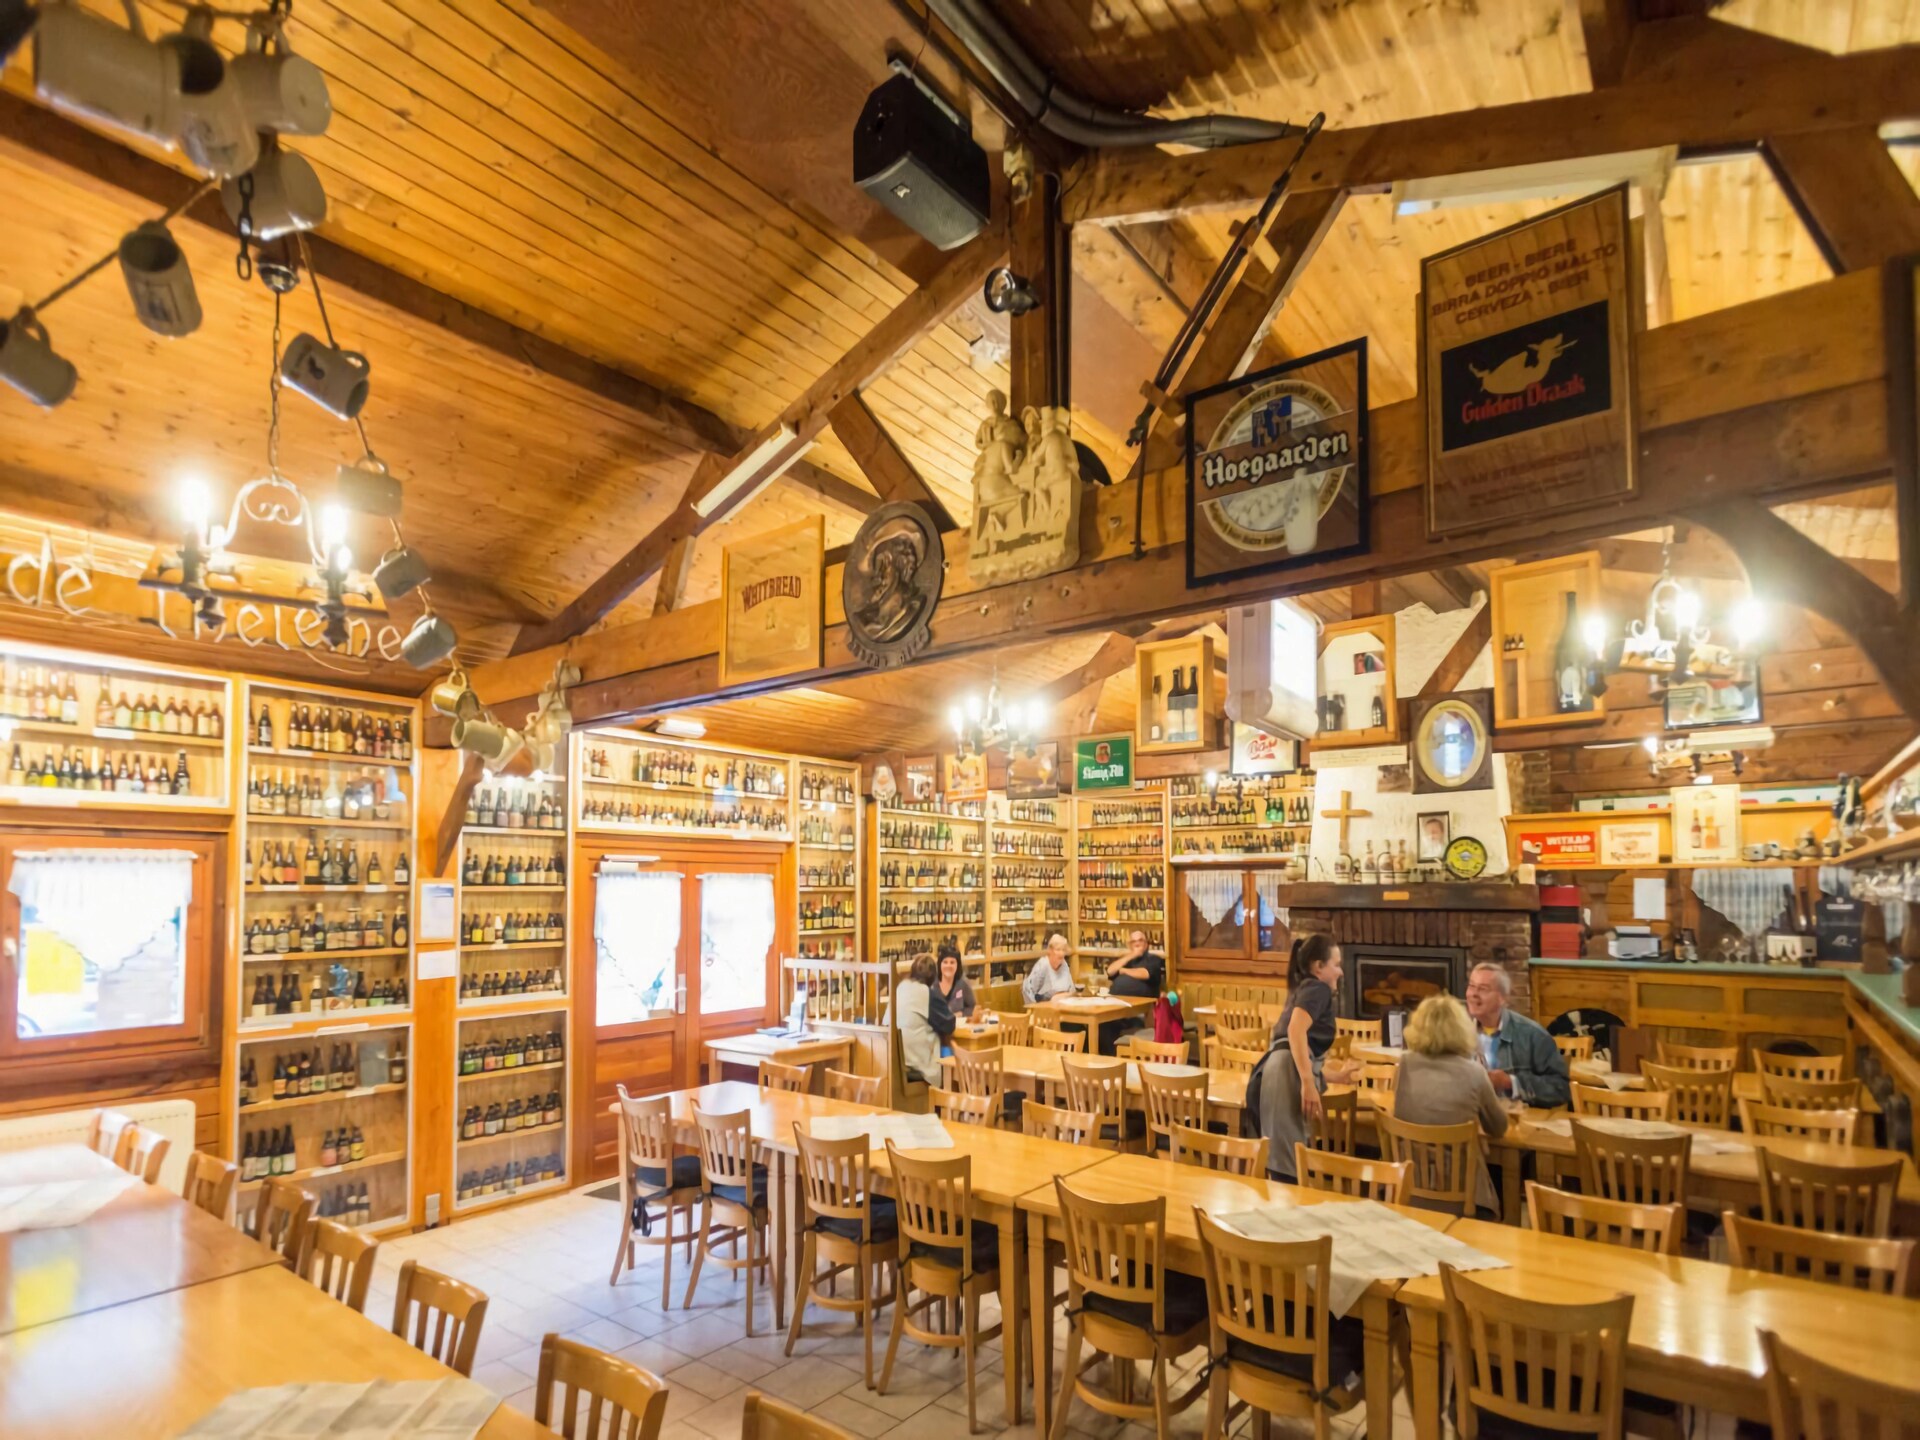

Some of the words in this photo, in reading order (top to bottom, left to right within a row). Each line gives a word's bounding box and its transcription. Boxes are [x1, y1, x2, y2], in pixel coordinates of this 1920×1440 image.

[1432, 290, 1481, 316] BIRRA
[1485, 266, 1549, 298] DOPPIO
[1555, 243, 1617, 273] MALTO
[1466, 264, 1510, 287] BEER
[1455, 292, 1532, 324] CERVEZA
[1463, 396, 1523, 423] Gulden
[1526, 375, 1585, 406] Draak
[1203, 433, 1350, 487] Hoegaarden
[741, 576, 801, 613] WHITBREAD
